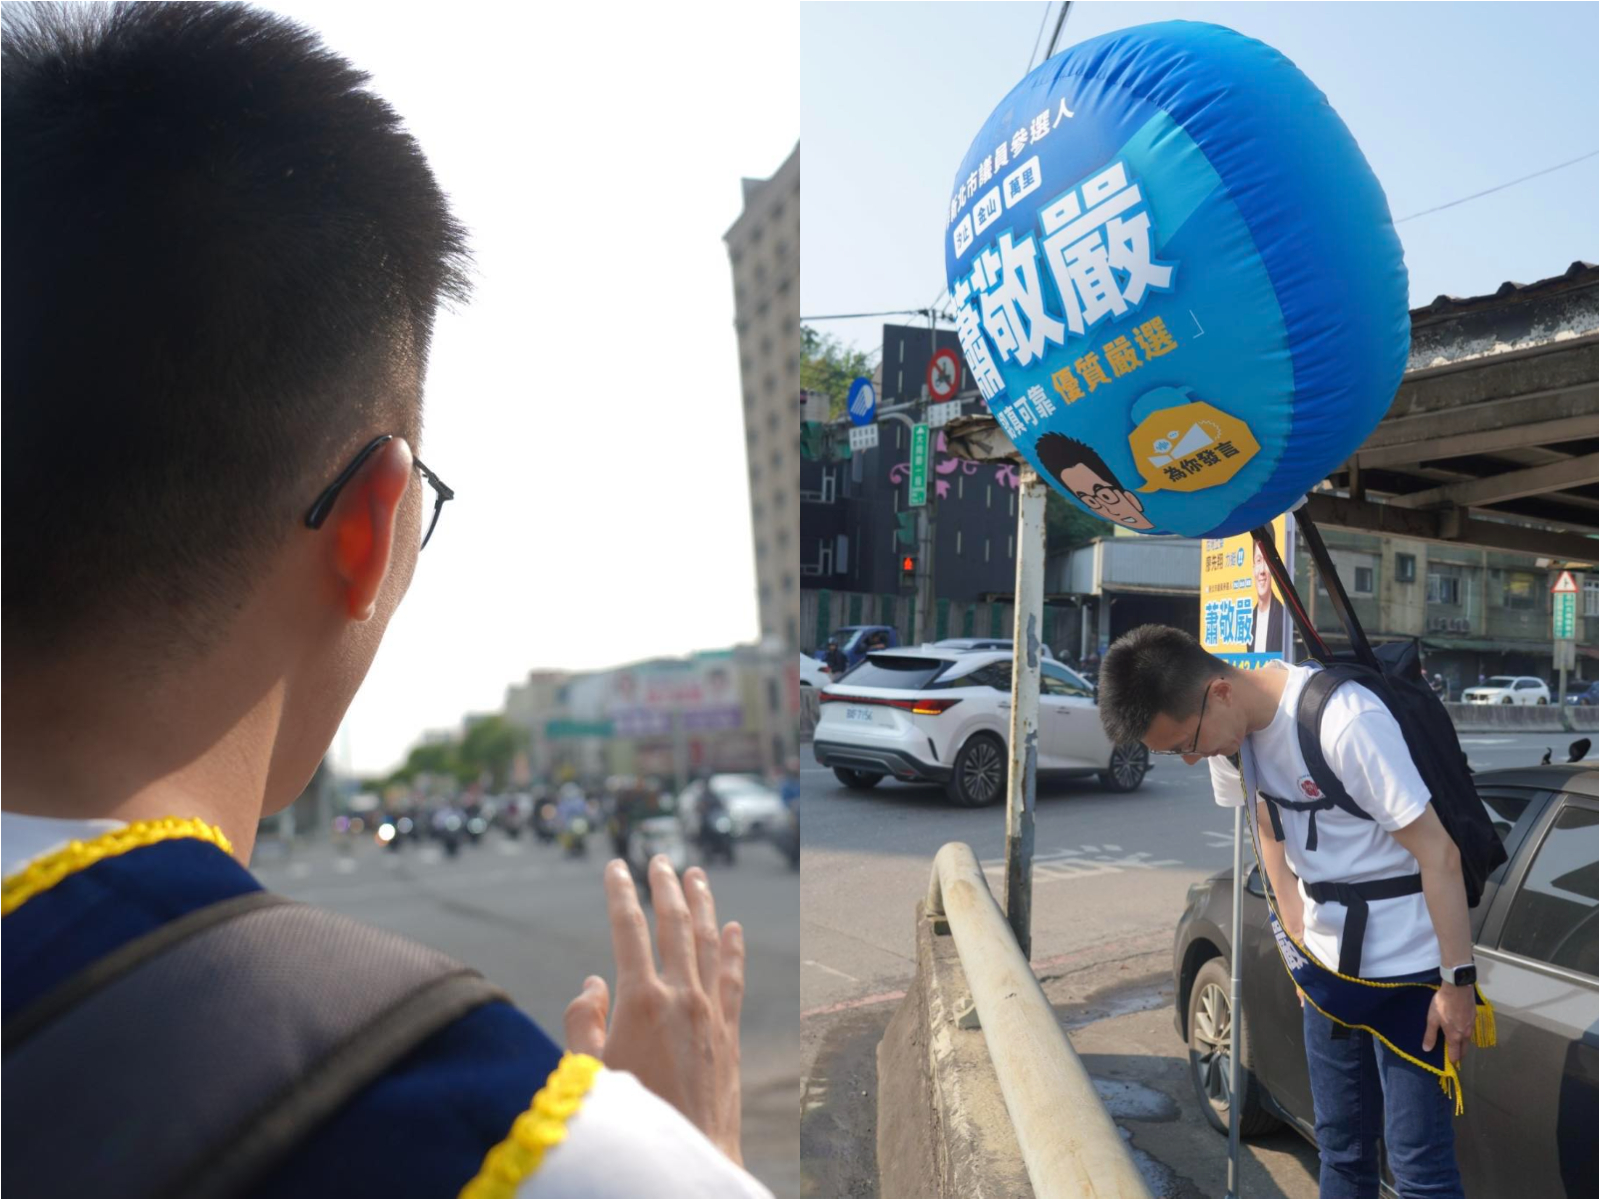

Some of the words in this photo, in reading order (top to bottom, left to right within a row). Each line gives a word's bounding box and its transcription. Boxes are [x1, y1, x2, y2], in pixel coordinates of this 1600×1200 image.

[1051, 316, 1178, 405] 優質嚴選
[1163, 441, 1240, 482] 為你發言
[1205, 597, 1253, 645] 蕭敬嚴
